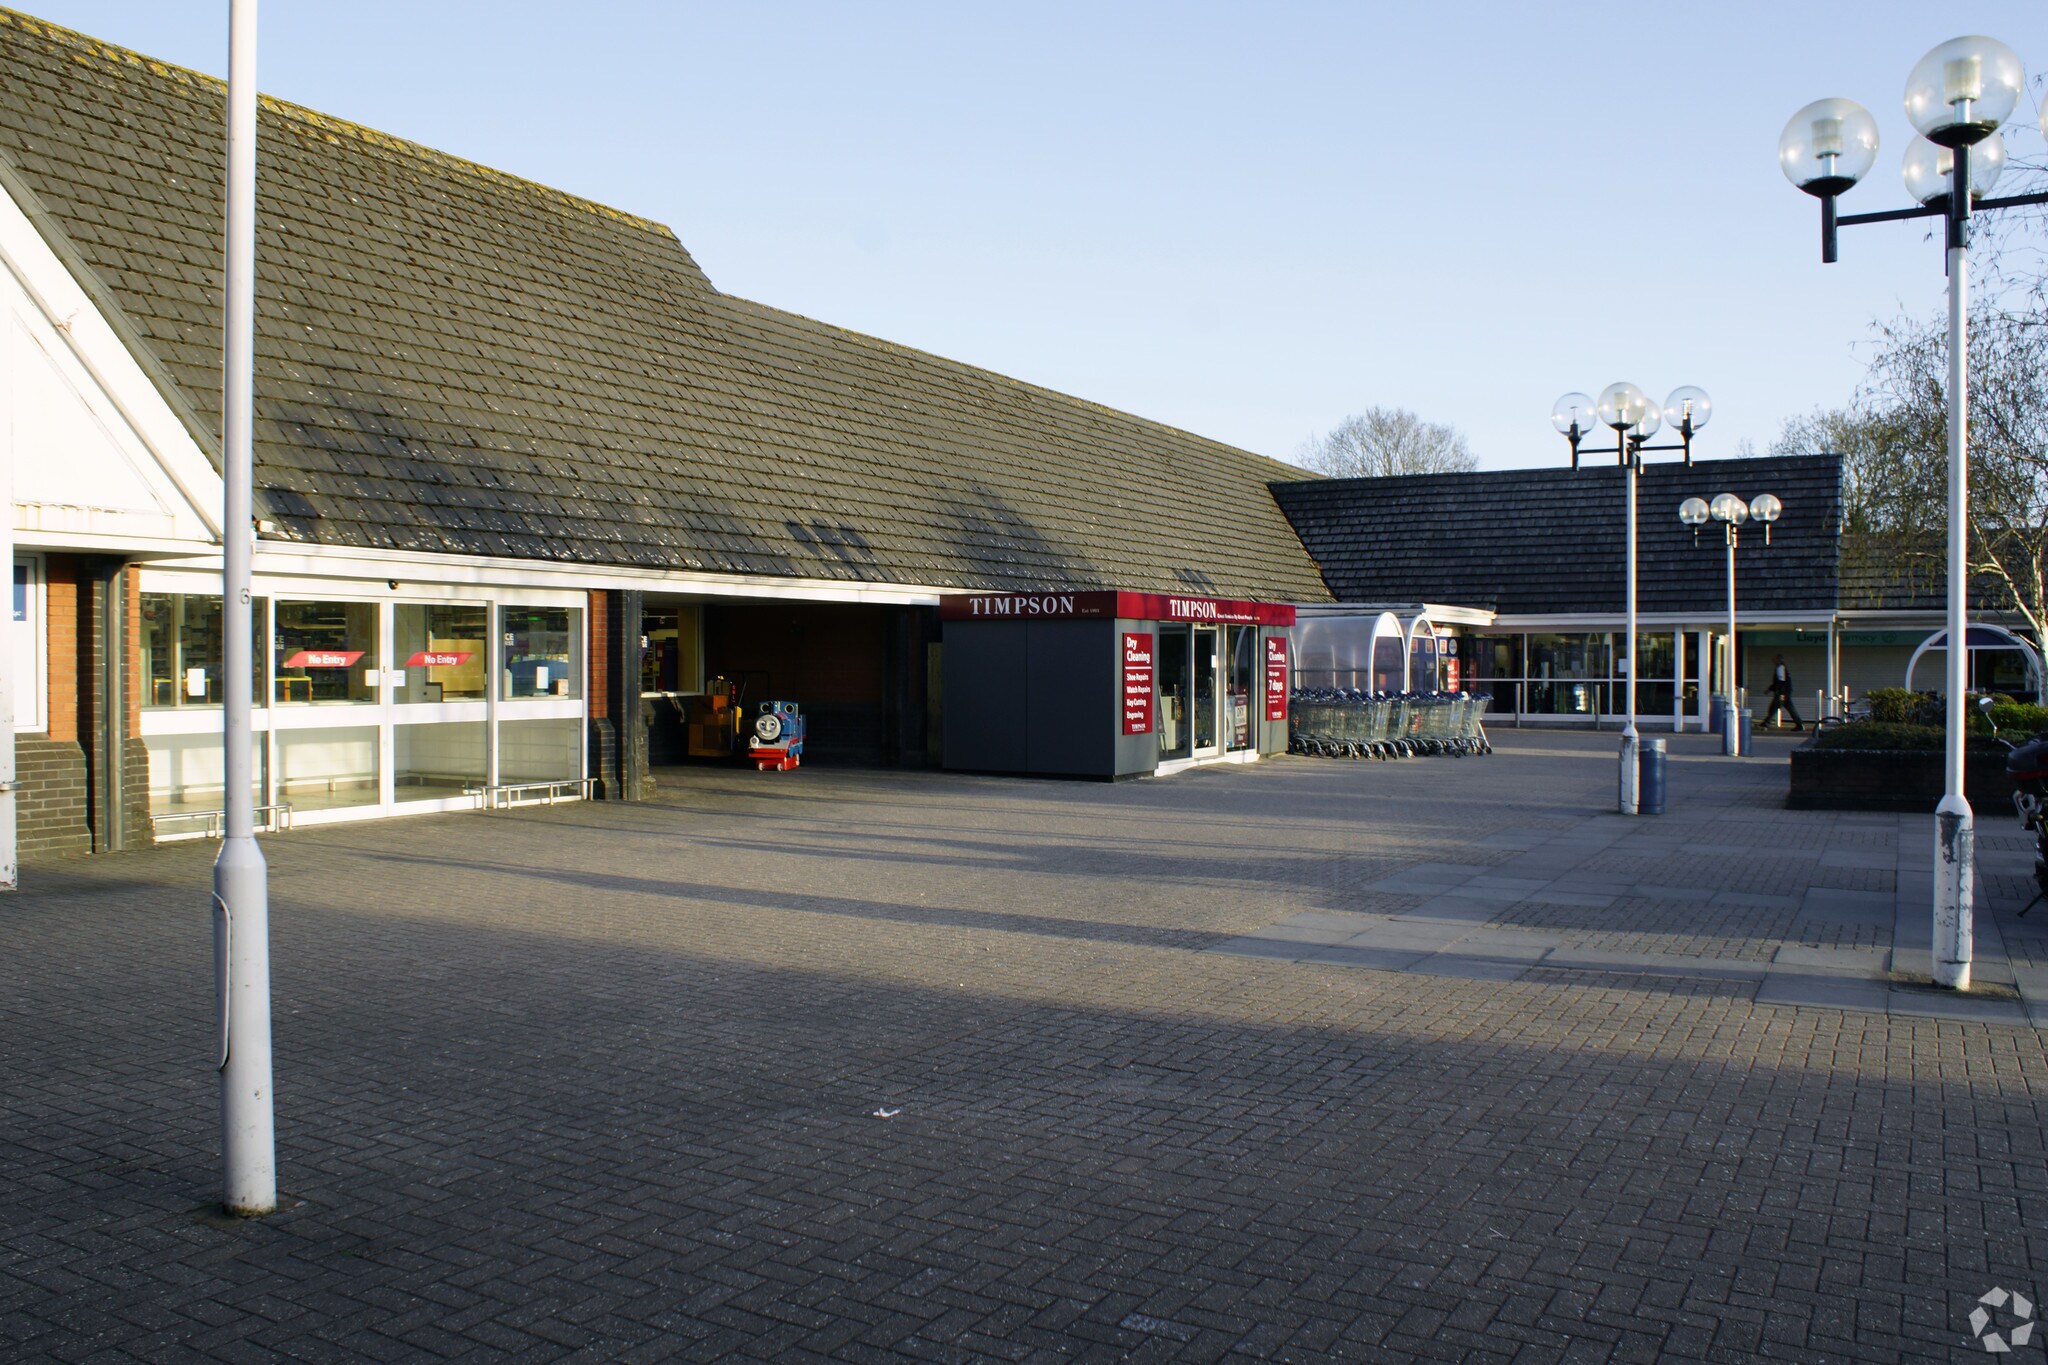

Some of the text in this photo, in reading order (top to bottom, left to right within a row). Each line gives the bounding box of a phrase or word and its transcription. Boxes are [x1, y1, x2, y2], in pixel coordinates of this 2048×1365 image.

[969, 596, 1074, 615] TIMPSON
[1170, 599, 1216, 619] TIMPSON
[1126, 636, 1137, 650] Dry
[308, 655, 346, 666] No Entry
[424, 655, 458, 666] No Entry
[1126, 650, 1150, 664] Cleaning
[1269, 651, 1285, 663] Cleaning
[1126, 673, 1149, 682] Shoe Repairs
[1138, 686, 1150, 694] Repairs
[1126, 711, 1144, 720] Engraving
